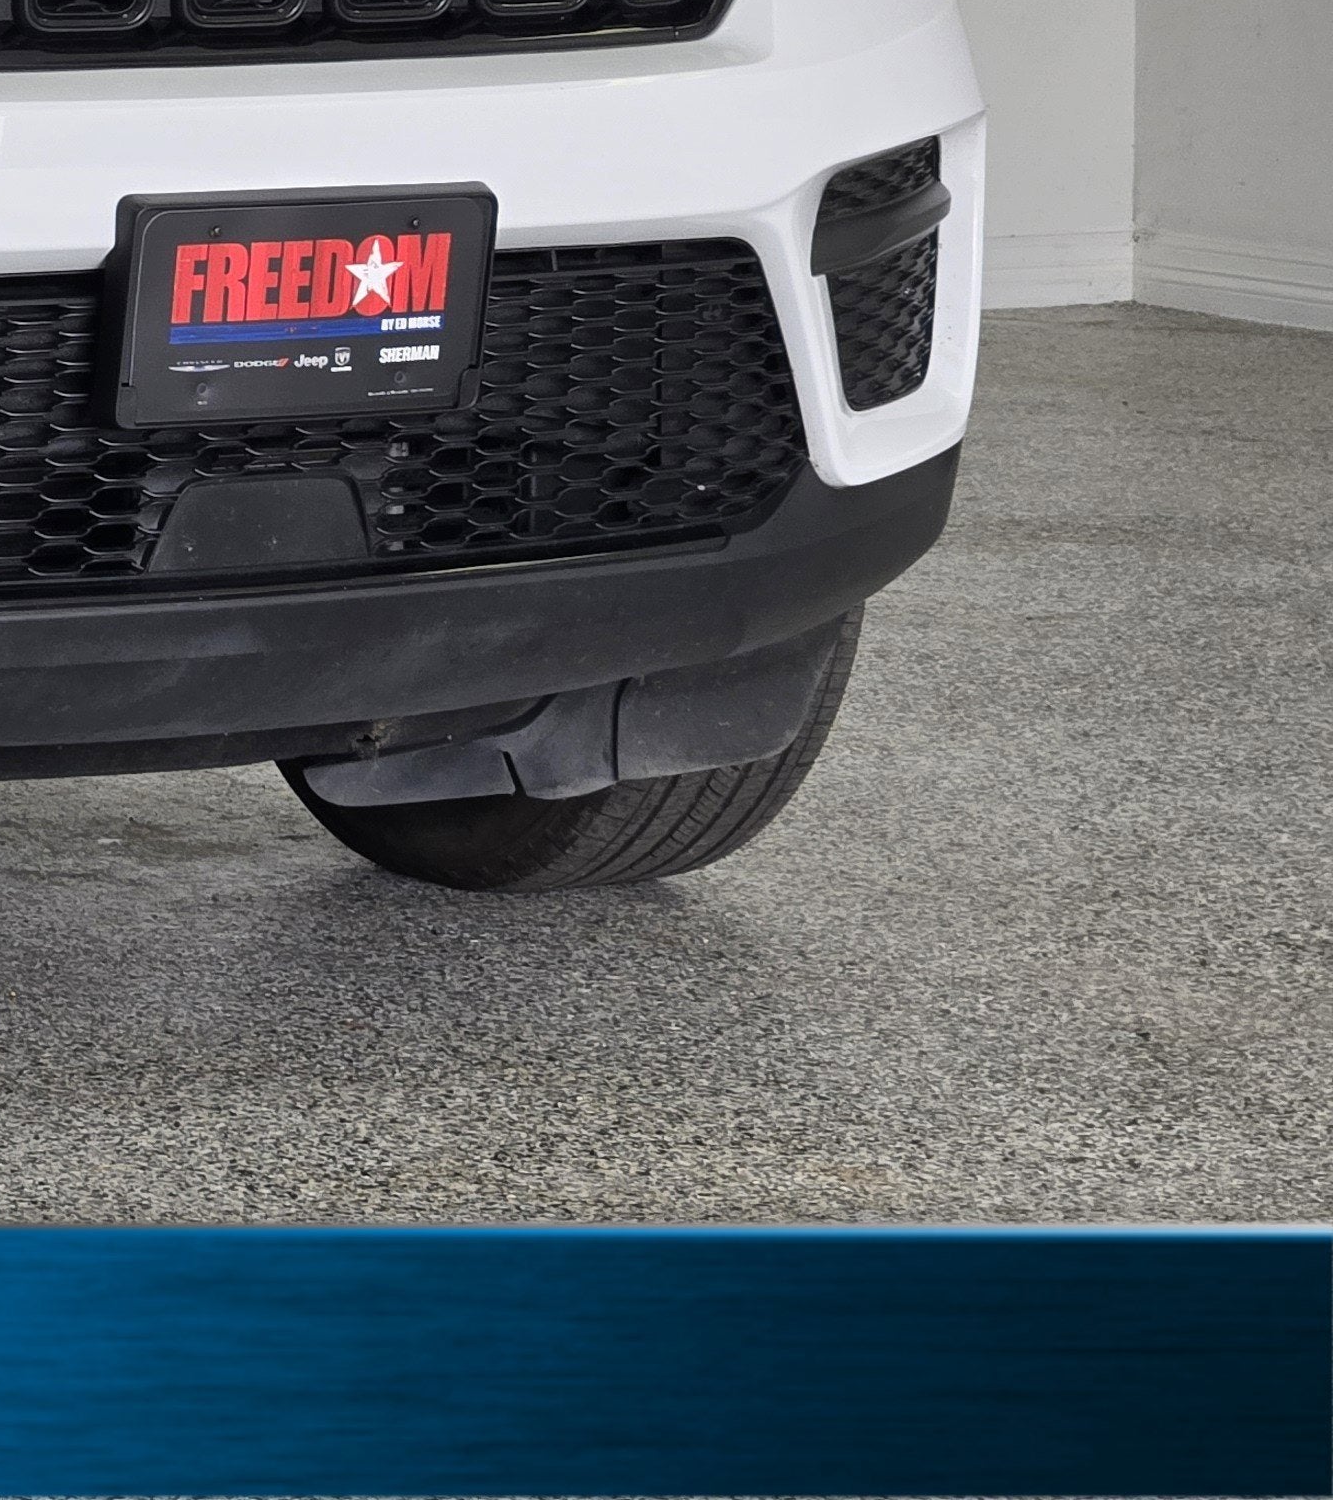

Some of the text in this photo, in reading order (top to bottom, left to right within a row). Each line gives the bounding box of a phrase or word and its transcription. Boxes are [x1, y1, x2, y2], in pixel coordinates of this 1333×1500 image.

[170, 232, 452, 324] FREEDOM
[380, 317, 395, 331] BY
[294, 353, 329, 370] Jeep
[378, 344, 441, 364] SHERMAN
